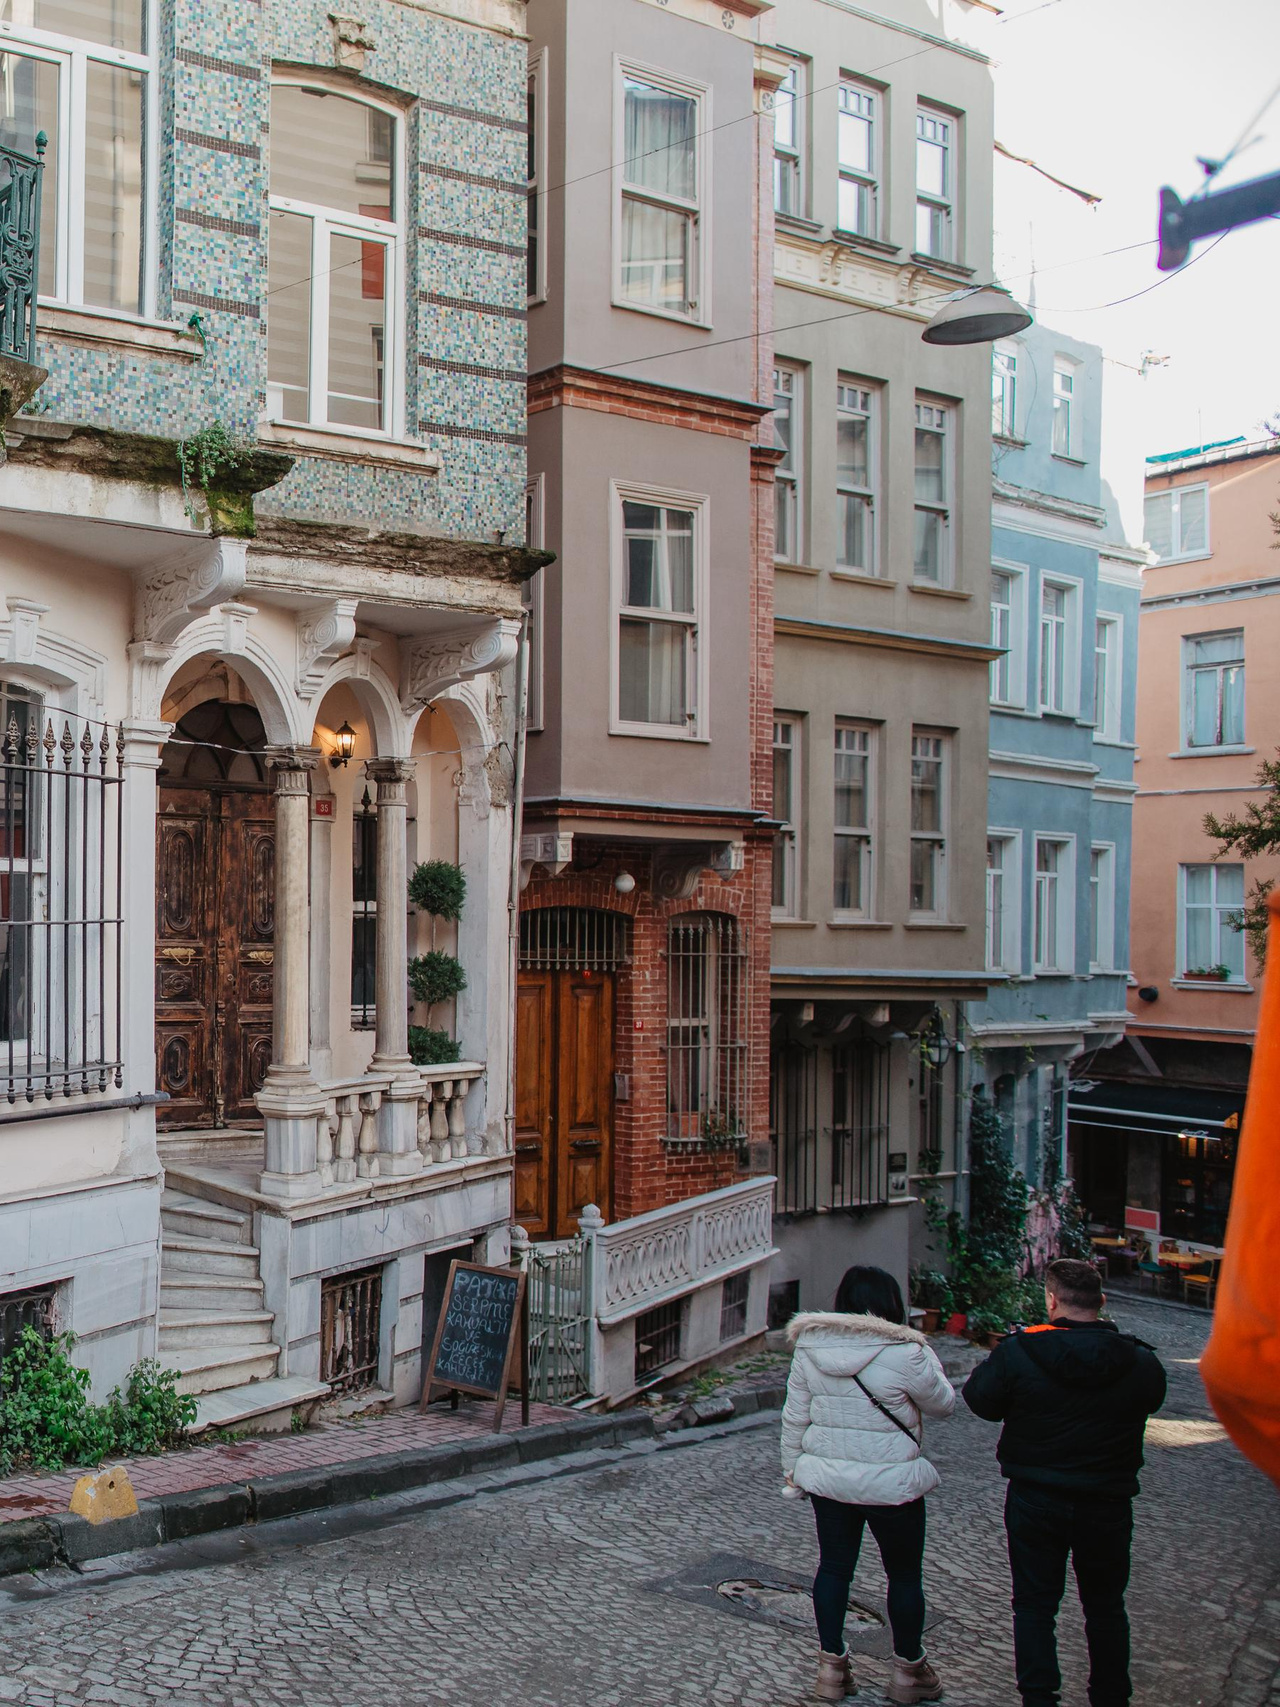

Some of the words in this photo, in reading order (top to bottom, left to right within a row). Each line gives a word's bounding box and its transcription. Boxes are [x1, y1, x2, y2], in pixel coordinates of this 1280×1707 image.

[320, 804, 329, 813] 35
[452, 1293, 511, 1320] SERPME
[447, 1310, 507, 1333] KAHVALTI
[464, 1330, 481, 1345] VE
